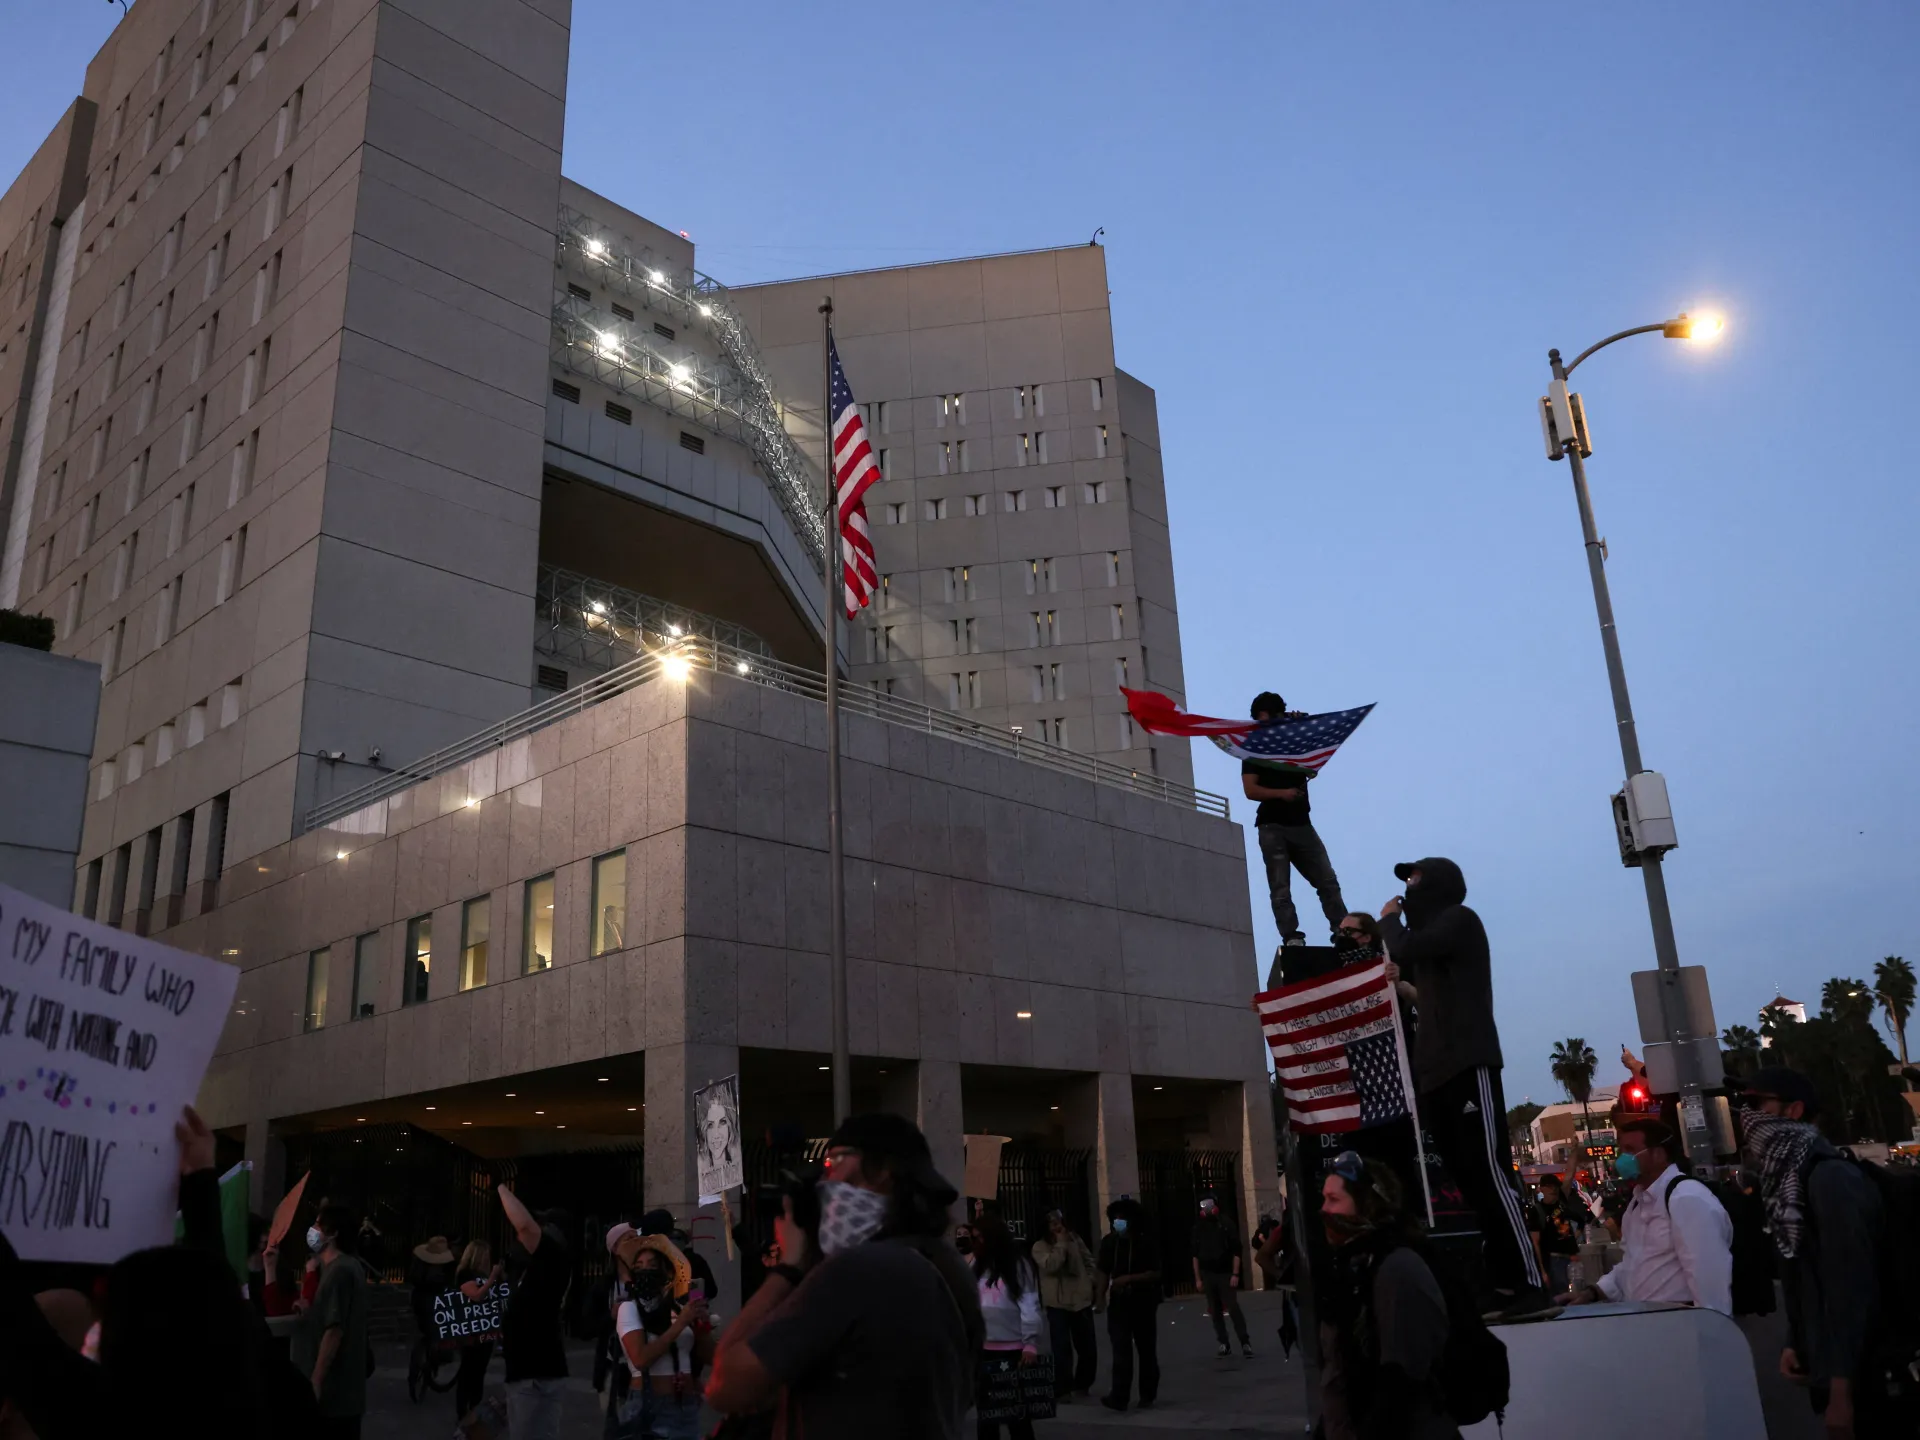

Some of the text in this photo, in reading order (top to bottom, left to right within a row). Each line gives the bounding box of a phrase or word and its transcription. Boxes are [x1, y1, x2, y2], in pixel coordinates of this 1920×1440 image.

[12, 916, 196, 1017] MY FAMILY WHO
[1281, 1015, 1313, 1033] THERE
[1327, 1007, 1340, 1021] NO
[1340, 1002, 1361, 1018] FLAG
[1363, 992, 1384, 1010] LARGE
[25, 994, 65, 1052] WITH
[123, 1028, 158, 1073] AND
[1322, 1034, 1335, 1046] TO
[1302, 1063, 1311, 1074] OF
[434, 1282, 511, 1310] ATTKS
[434, 1309, 457, 1325] ON
